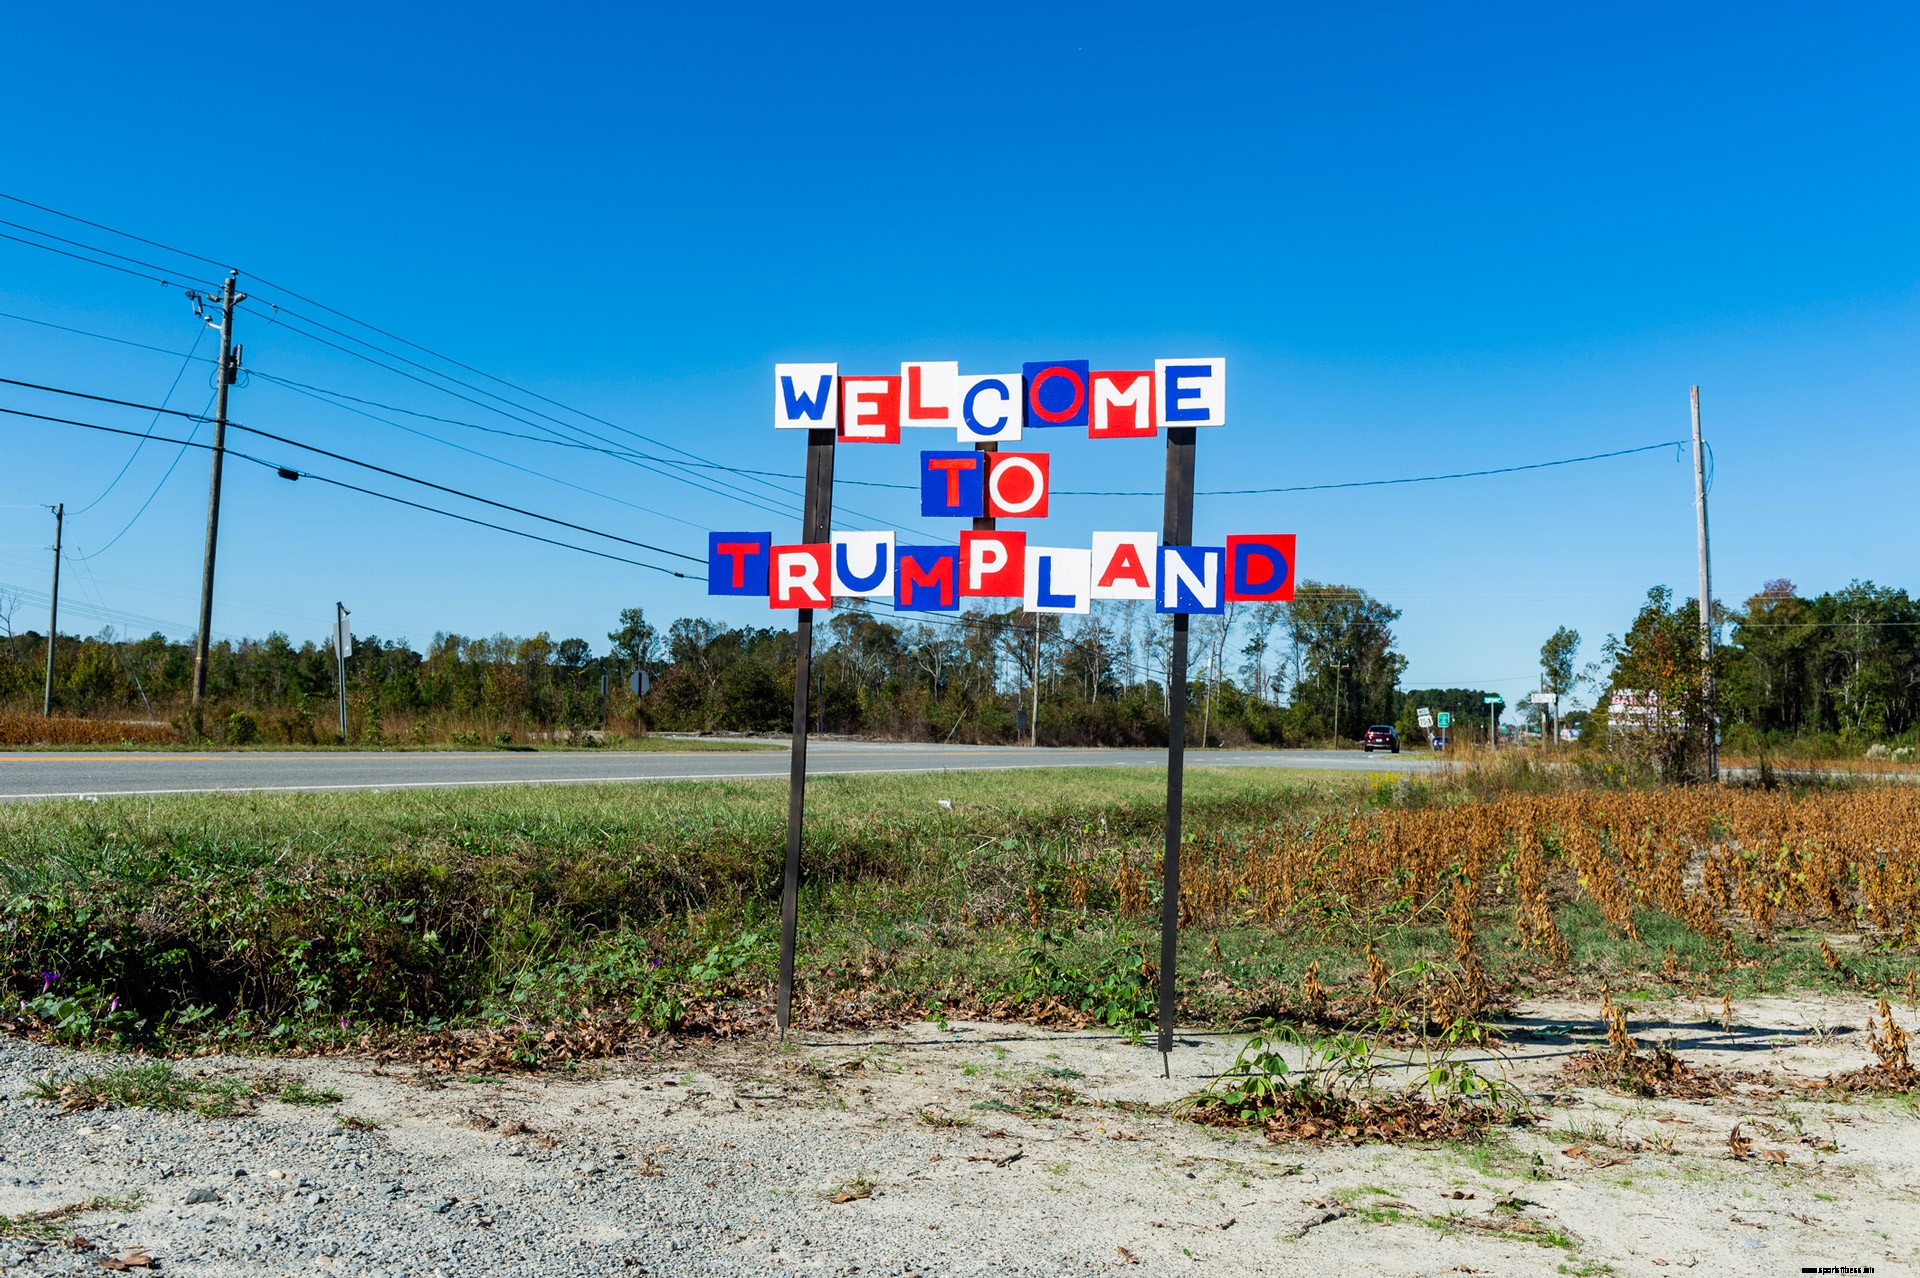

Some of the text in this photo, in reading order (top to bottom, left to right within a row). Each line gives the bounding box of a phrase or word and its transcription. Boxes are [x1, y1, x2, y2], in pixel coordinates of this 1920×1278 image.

[780, 366, 1212, 436] WELCOME
[929, 458, 1044, 513] TO
[717, 539, 1288, 608] TRUMPLAND
